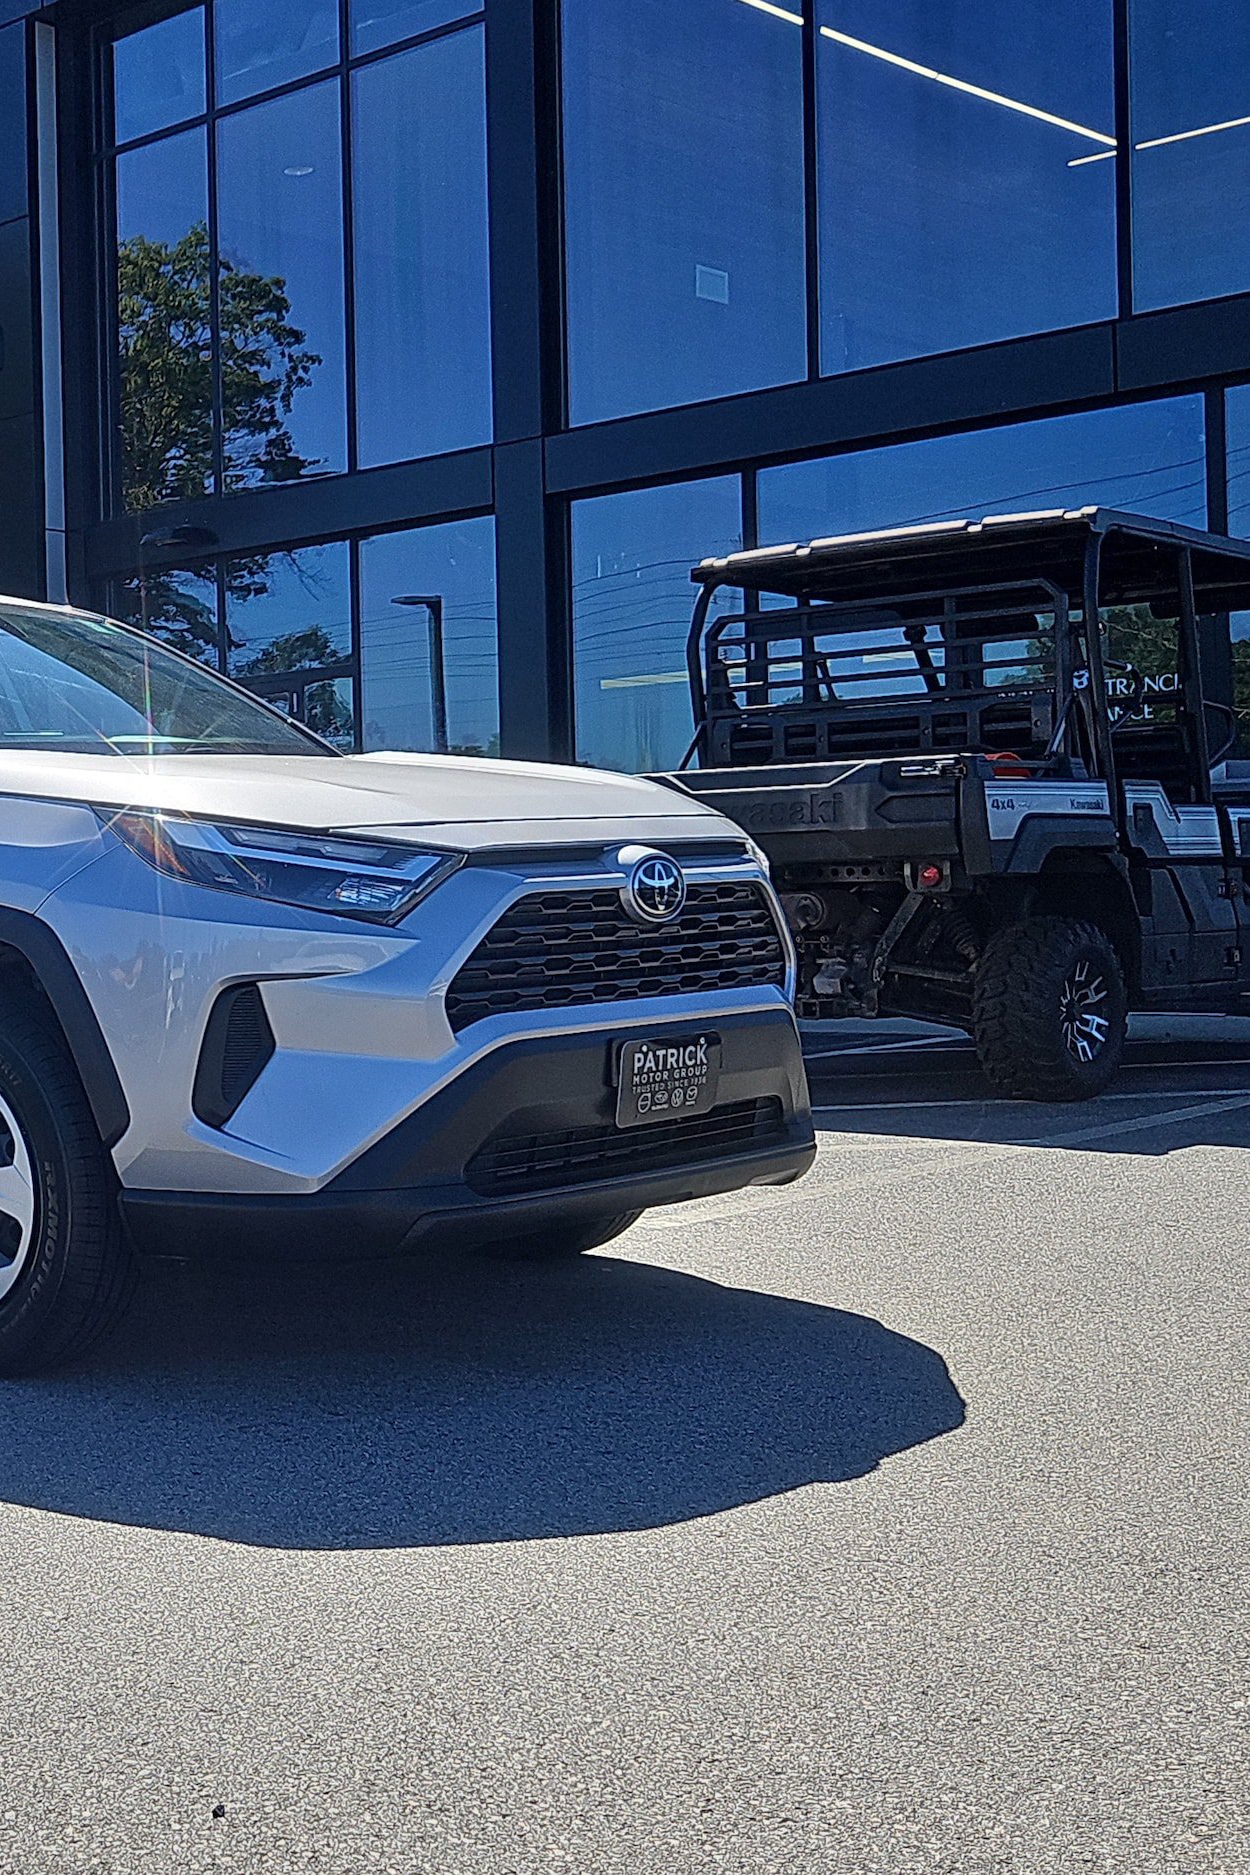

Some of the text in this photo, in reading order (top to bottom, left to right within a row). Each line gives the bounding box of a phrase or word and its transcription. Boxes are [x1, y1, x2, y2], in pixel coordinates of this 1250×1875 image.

[991, 799, 1015, 810] 4x4
[1070, 799, 1104, 810] Kawasaki
[633, 1044, 707, 1074] PATRICK
[633, 1065, 707, 1085] MOTOR GROUP
[633, 1082, 665, 1094] TRUSTED
[668, 1079, 688, 1089] SINCE
